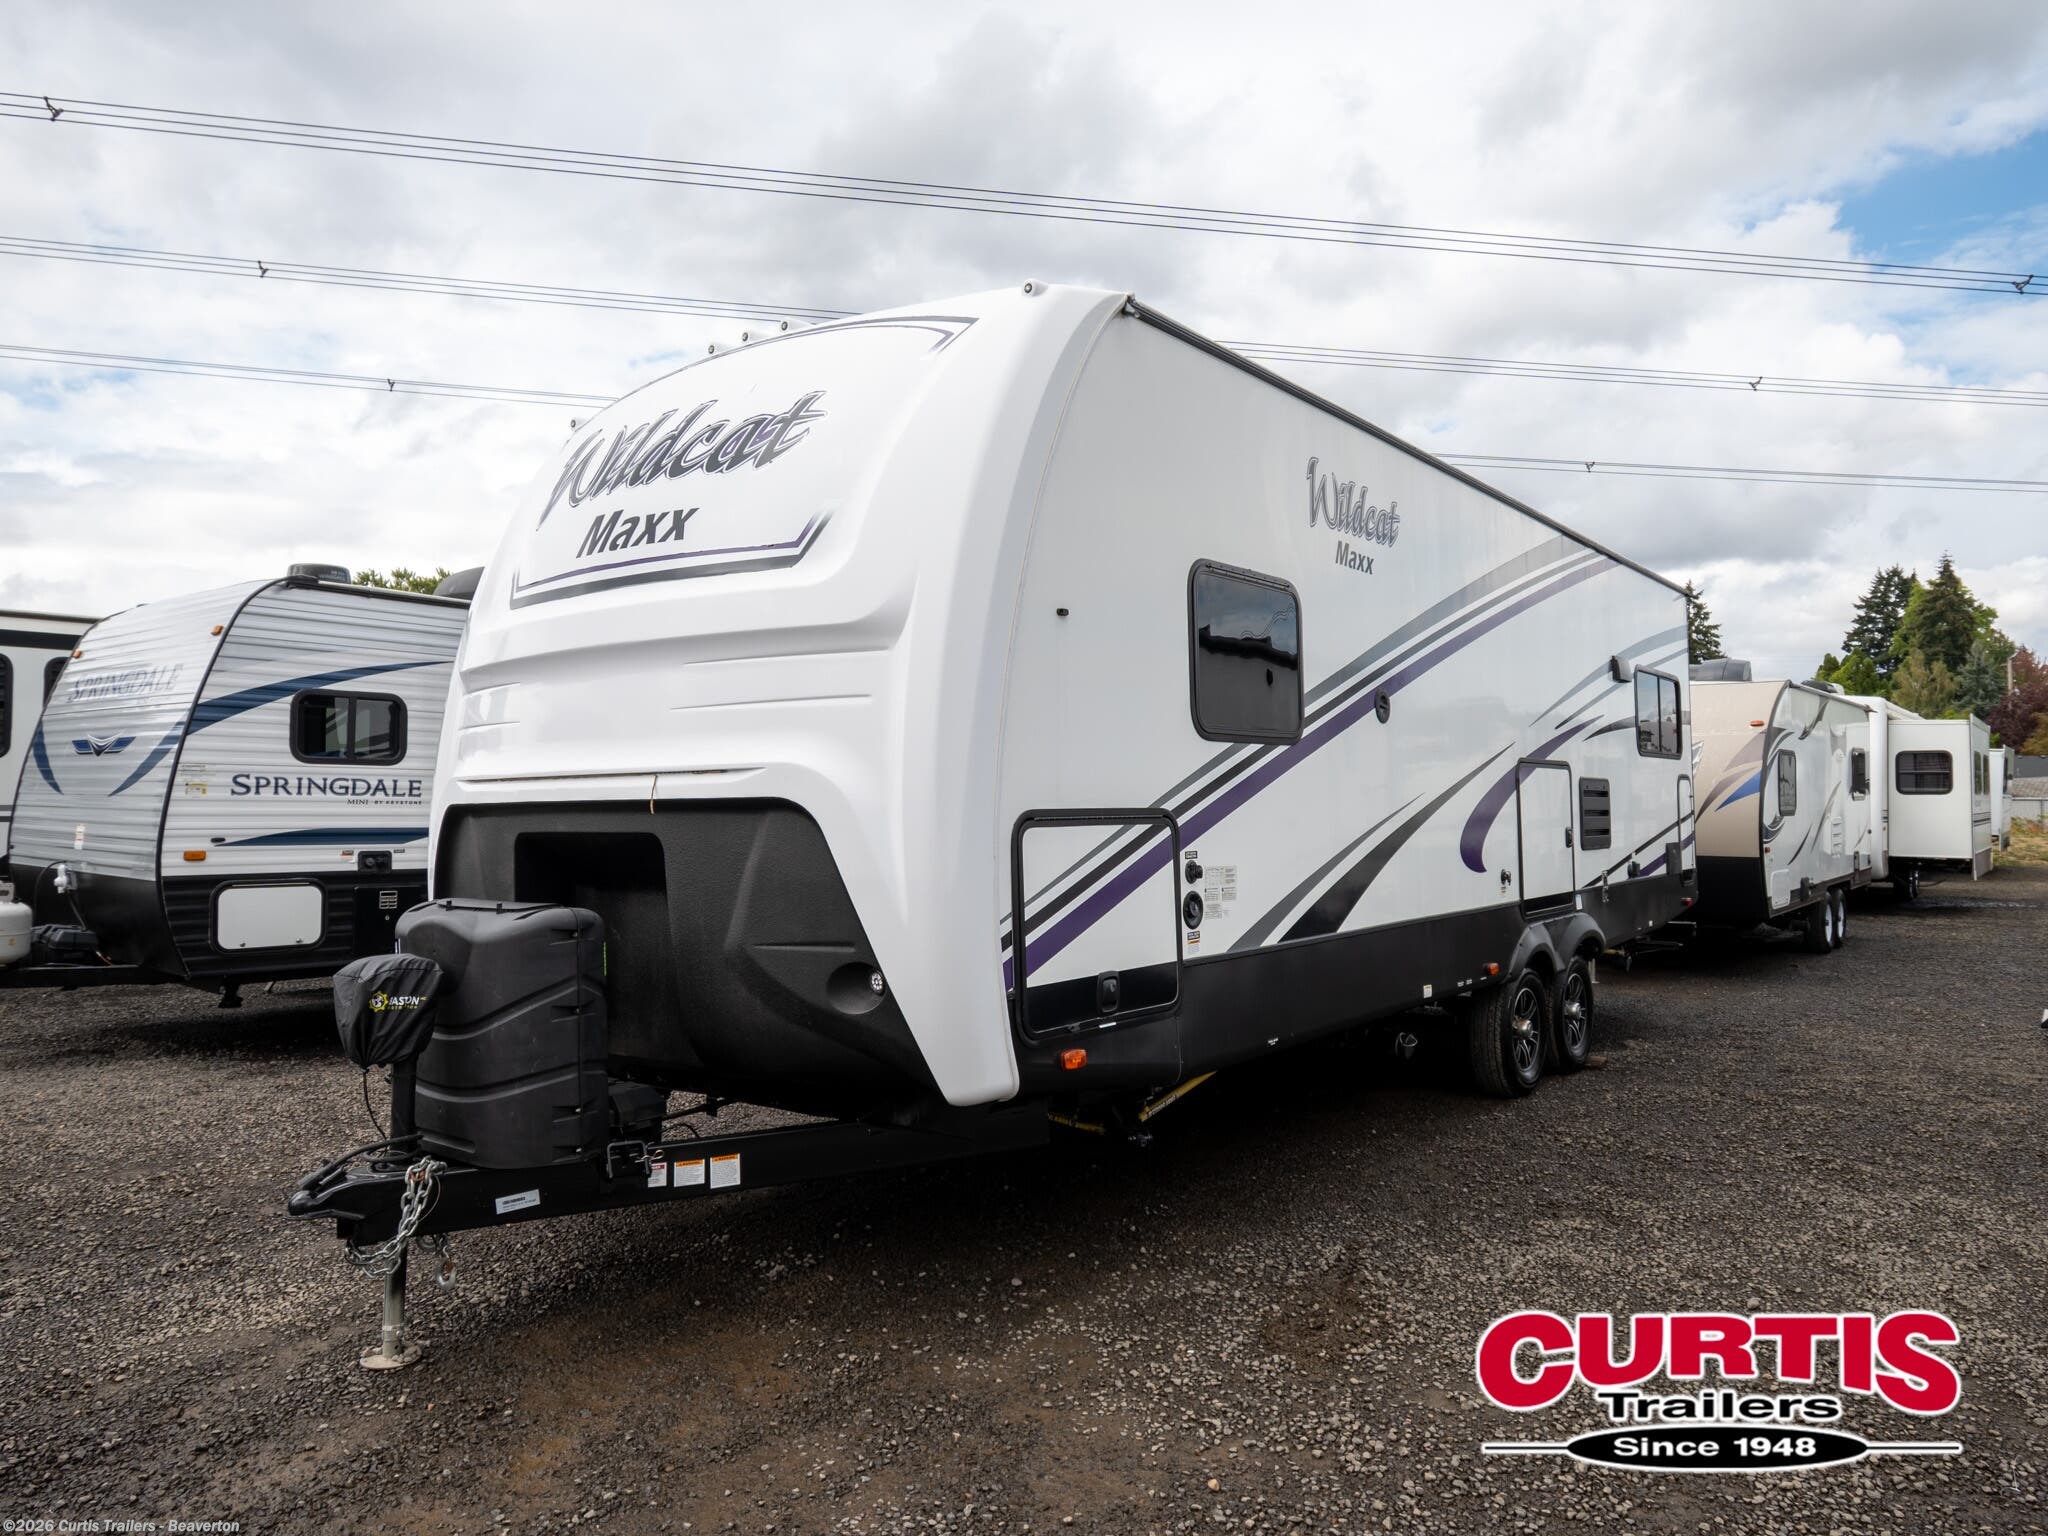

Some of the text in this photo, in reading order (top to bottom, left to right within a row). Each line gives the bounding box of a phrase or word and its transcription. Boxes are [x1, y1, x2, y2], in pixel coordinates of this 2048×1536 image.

[536, 390, 828, 531] Wildcat
[1306, 456, 1401, 548] Wildcat
[575, 507, 700, 559] Maxx
[1335, 540, 1375, 575] Maxx
[230, 773, 422, 798] SPRINGDALE
